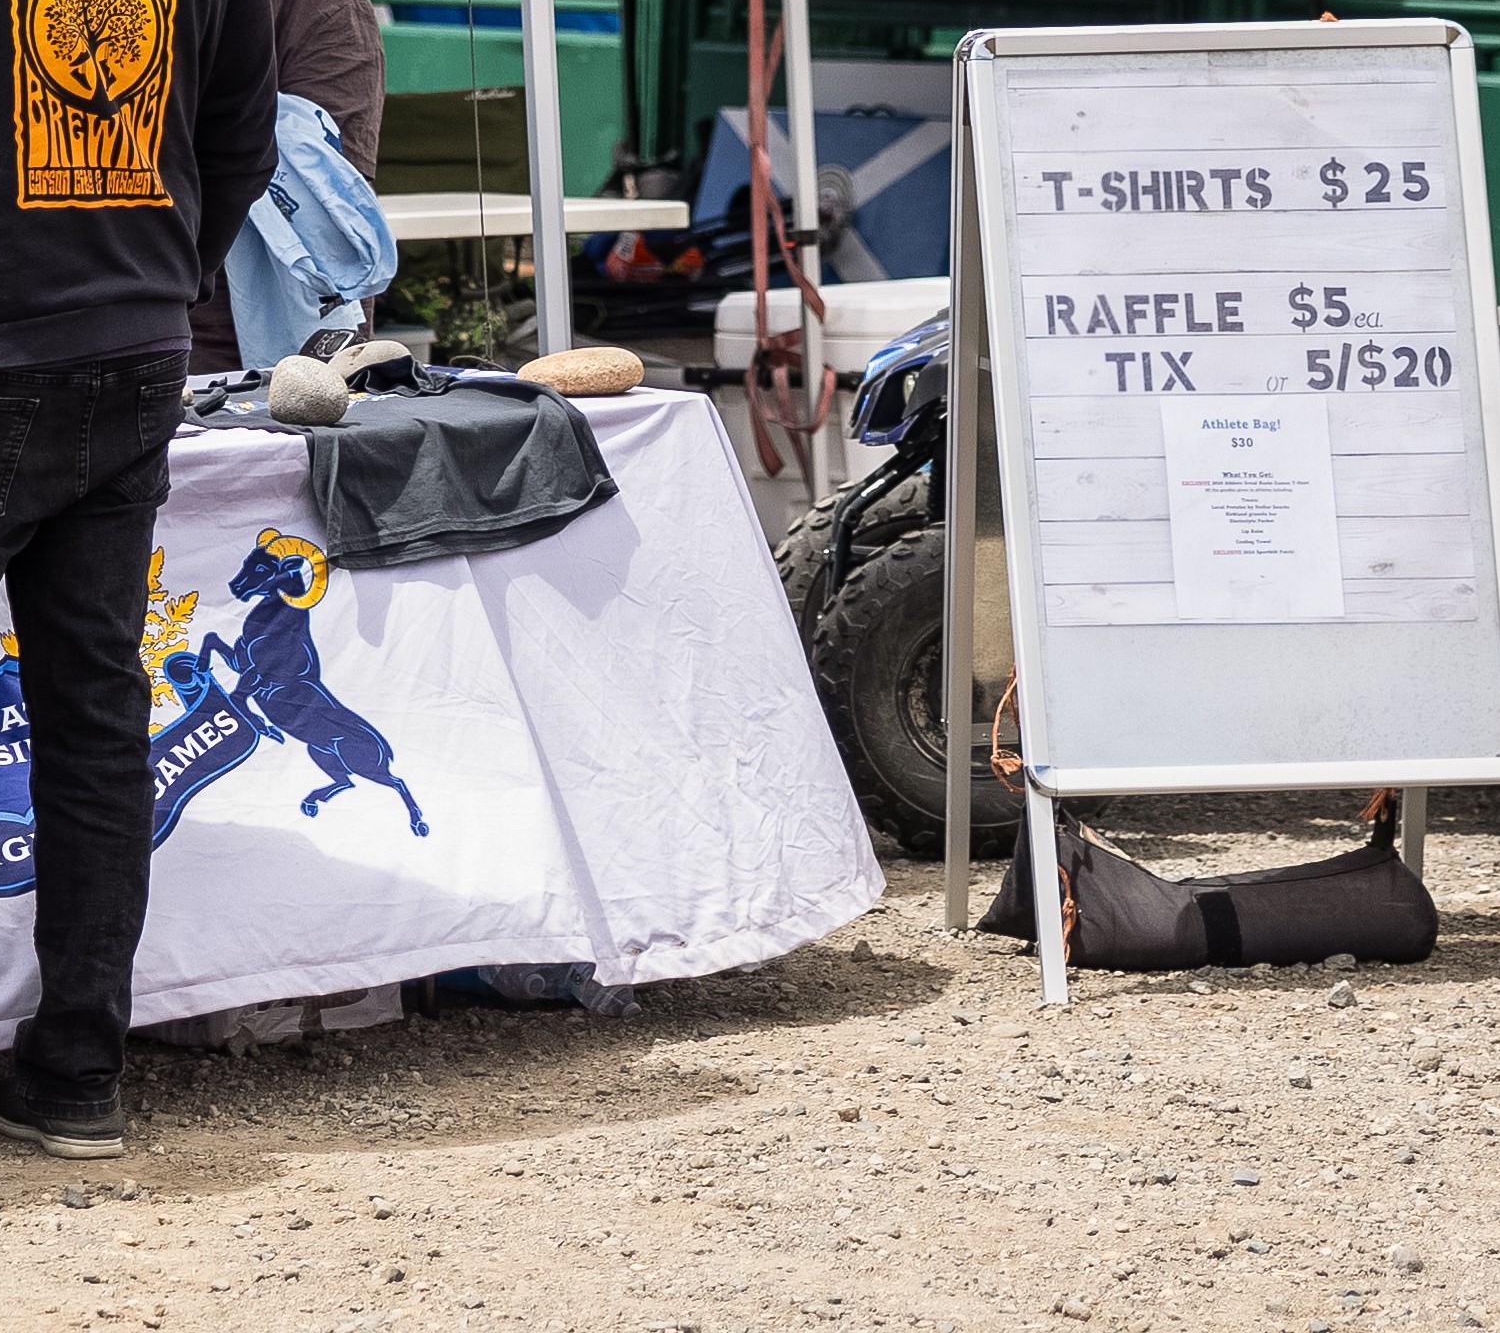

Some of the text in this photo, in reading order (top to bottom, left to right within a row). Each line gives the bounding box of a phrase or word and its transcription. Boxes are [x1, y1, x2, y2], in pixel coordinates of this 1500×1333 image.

[1042, 167, 1273, 212] T-SHIRTS
[1045, 290, 1244, 335] RAFFLE
[1288, 282, 1351, 333] $5
[1105, 351, 1197, 393] TIX
[1305, 339, 1452, 392] 5/$20
[1202, 419, 1281, 431] Athlete Bag!
[1231, 437, 1254, 448] $30
